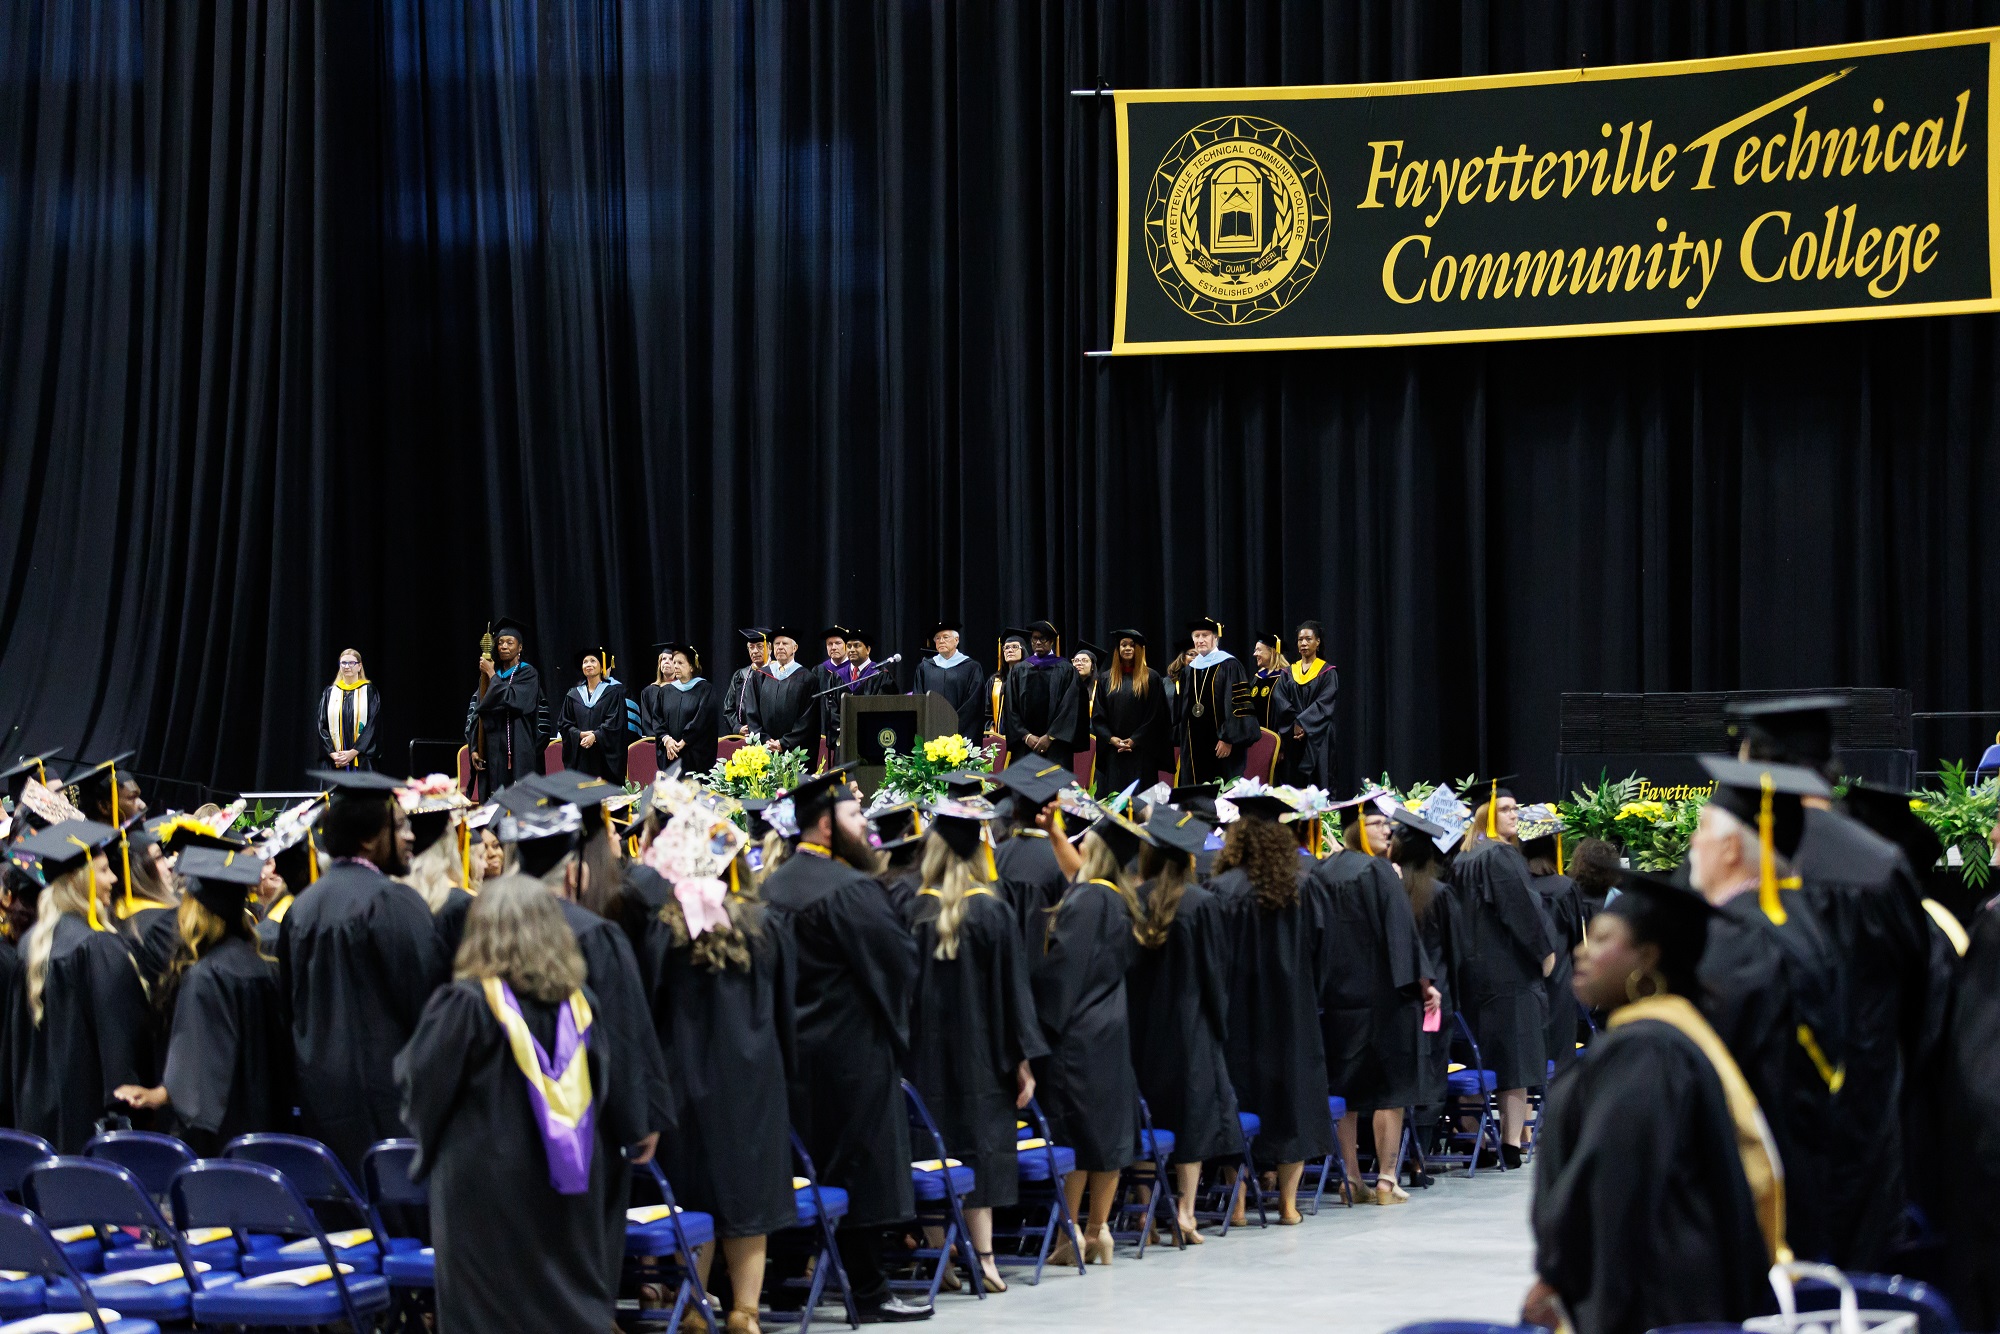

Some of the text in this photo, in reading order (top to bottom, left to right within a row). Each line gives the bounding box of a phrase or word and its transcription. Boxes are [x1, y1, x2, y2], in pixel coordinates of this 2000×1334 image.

[1169, 144, 1305, 246] FAYETTEVILLE TECHNICAL COMMUNITY COLLEGE
[1356, 66, 1971, 228] Fayetteville Technical
[1197, 251, 1277, 273] ESSE QUAM VIDERI
[1198, 278, 1273, 297] ESTABLISHED 1961
[1382, 203, 1941, 310] Community College
